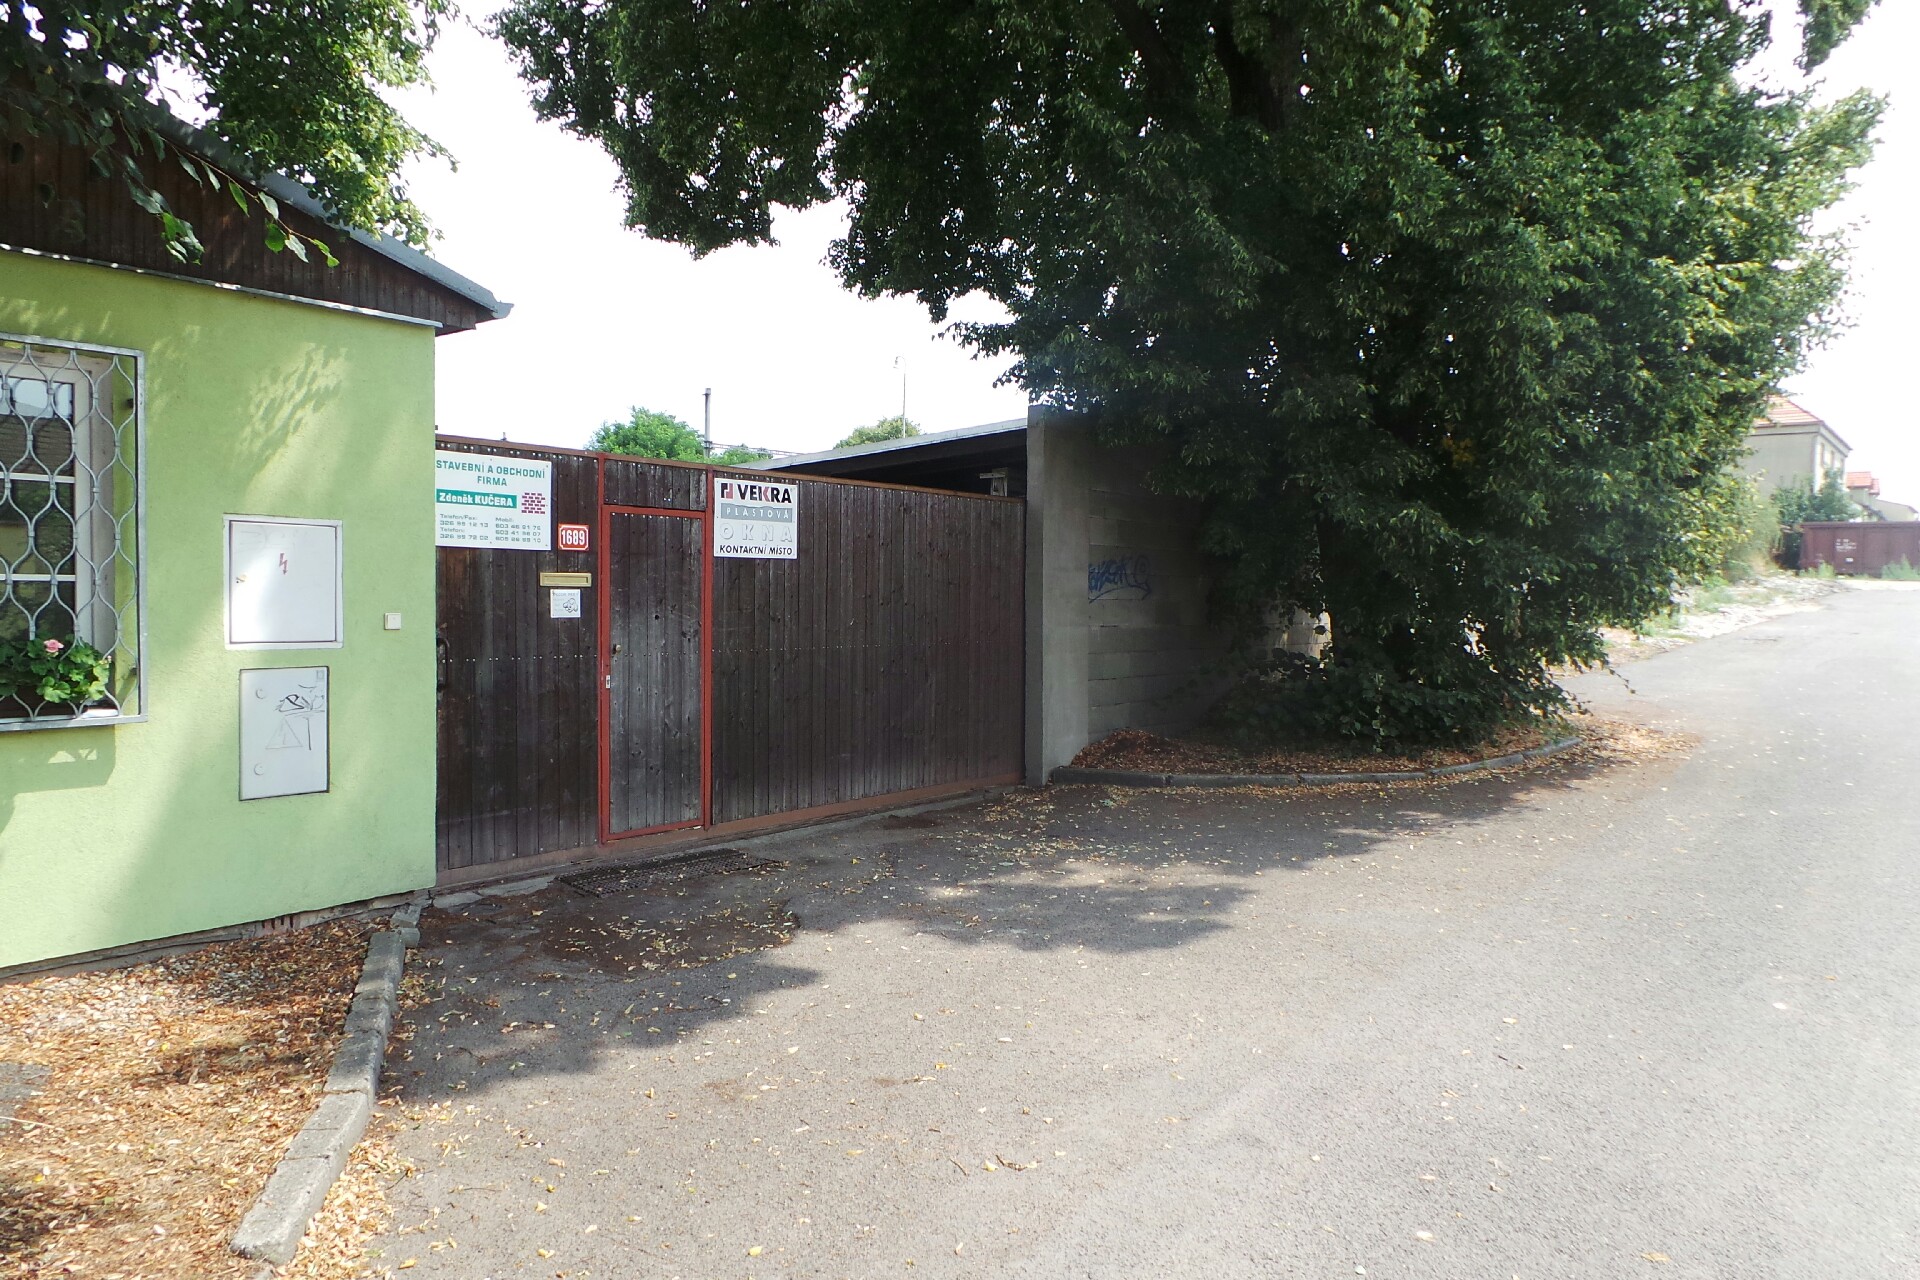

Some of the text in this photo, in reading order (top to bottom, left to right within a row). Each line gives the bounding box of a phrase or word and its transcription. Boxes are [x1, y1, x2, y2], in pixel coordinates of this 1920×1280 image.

[436, 460, 546, 479] STAVEBNÍ A OBCHODNÍ
[477, 475, 508, 487] FIRMA
[439, 492, 514, 507] Zdeněk KUČERA
[737, 484, 792, 504] VEKRA
[562, 529, 585, 546] 1689
[720, 522, 793, 543] OKNA
[720, 544, 793, 555] KONTAKTNÍ MÍSTO
